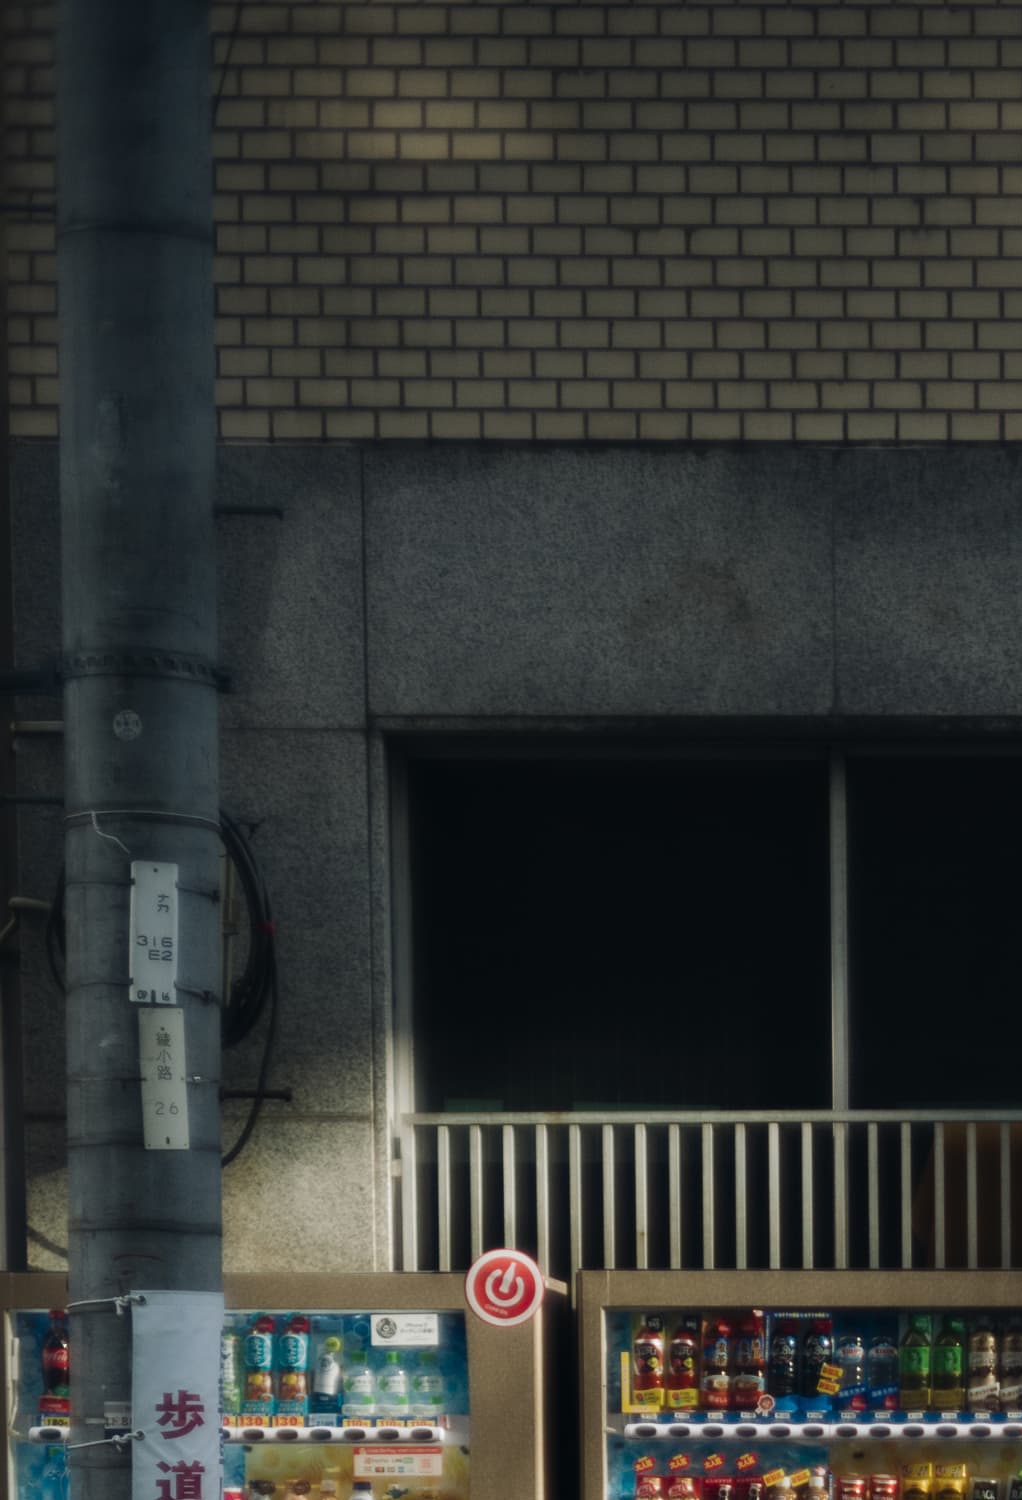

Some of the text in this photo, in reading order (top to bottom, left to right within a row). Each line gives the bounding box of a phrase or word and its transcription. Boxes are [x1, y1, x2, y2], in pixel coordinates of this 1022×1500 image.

[157, 893, 171, 912] ナカ
[136, 934, 173, 949] 316
[148, 949, 173, 962] E2
[154, 1101, 179, 1116] 26
